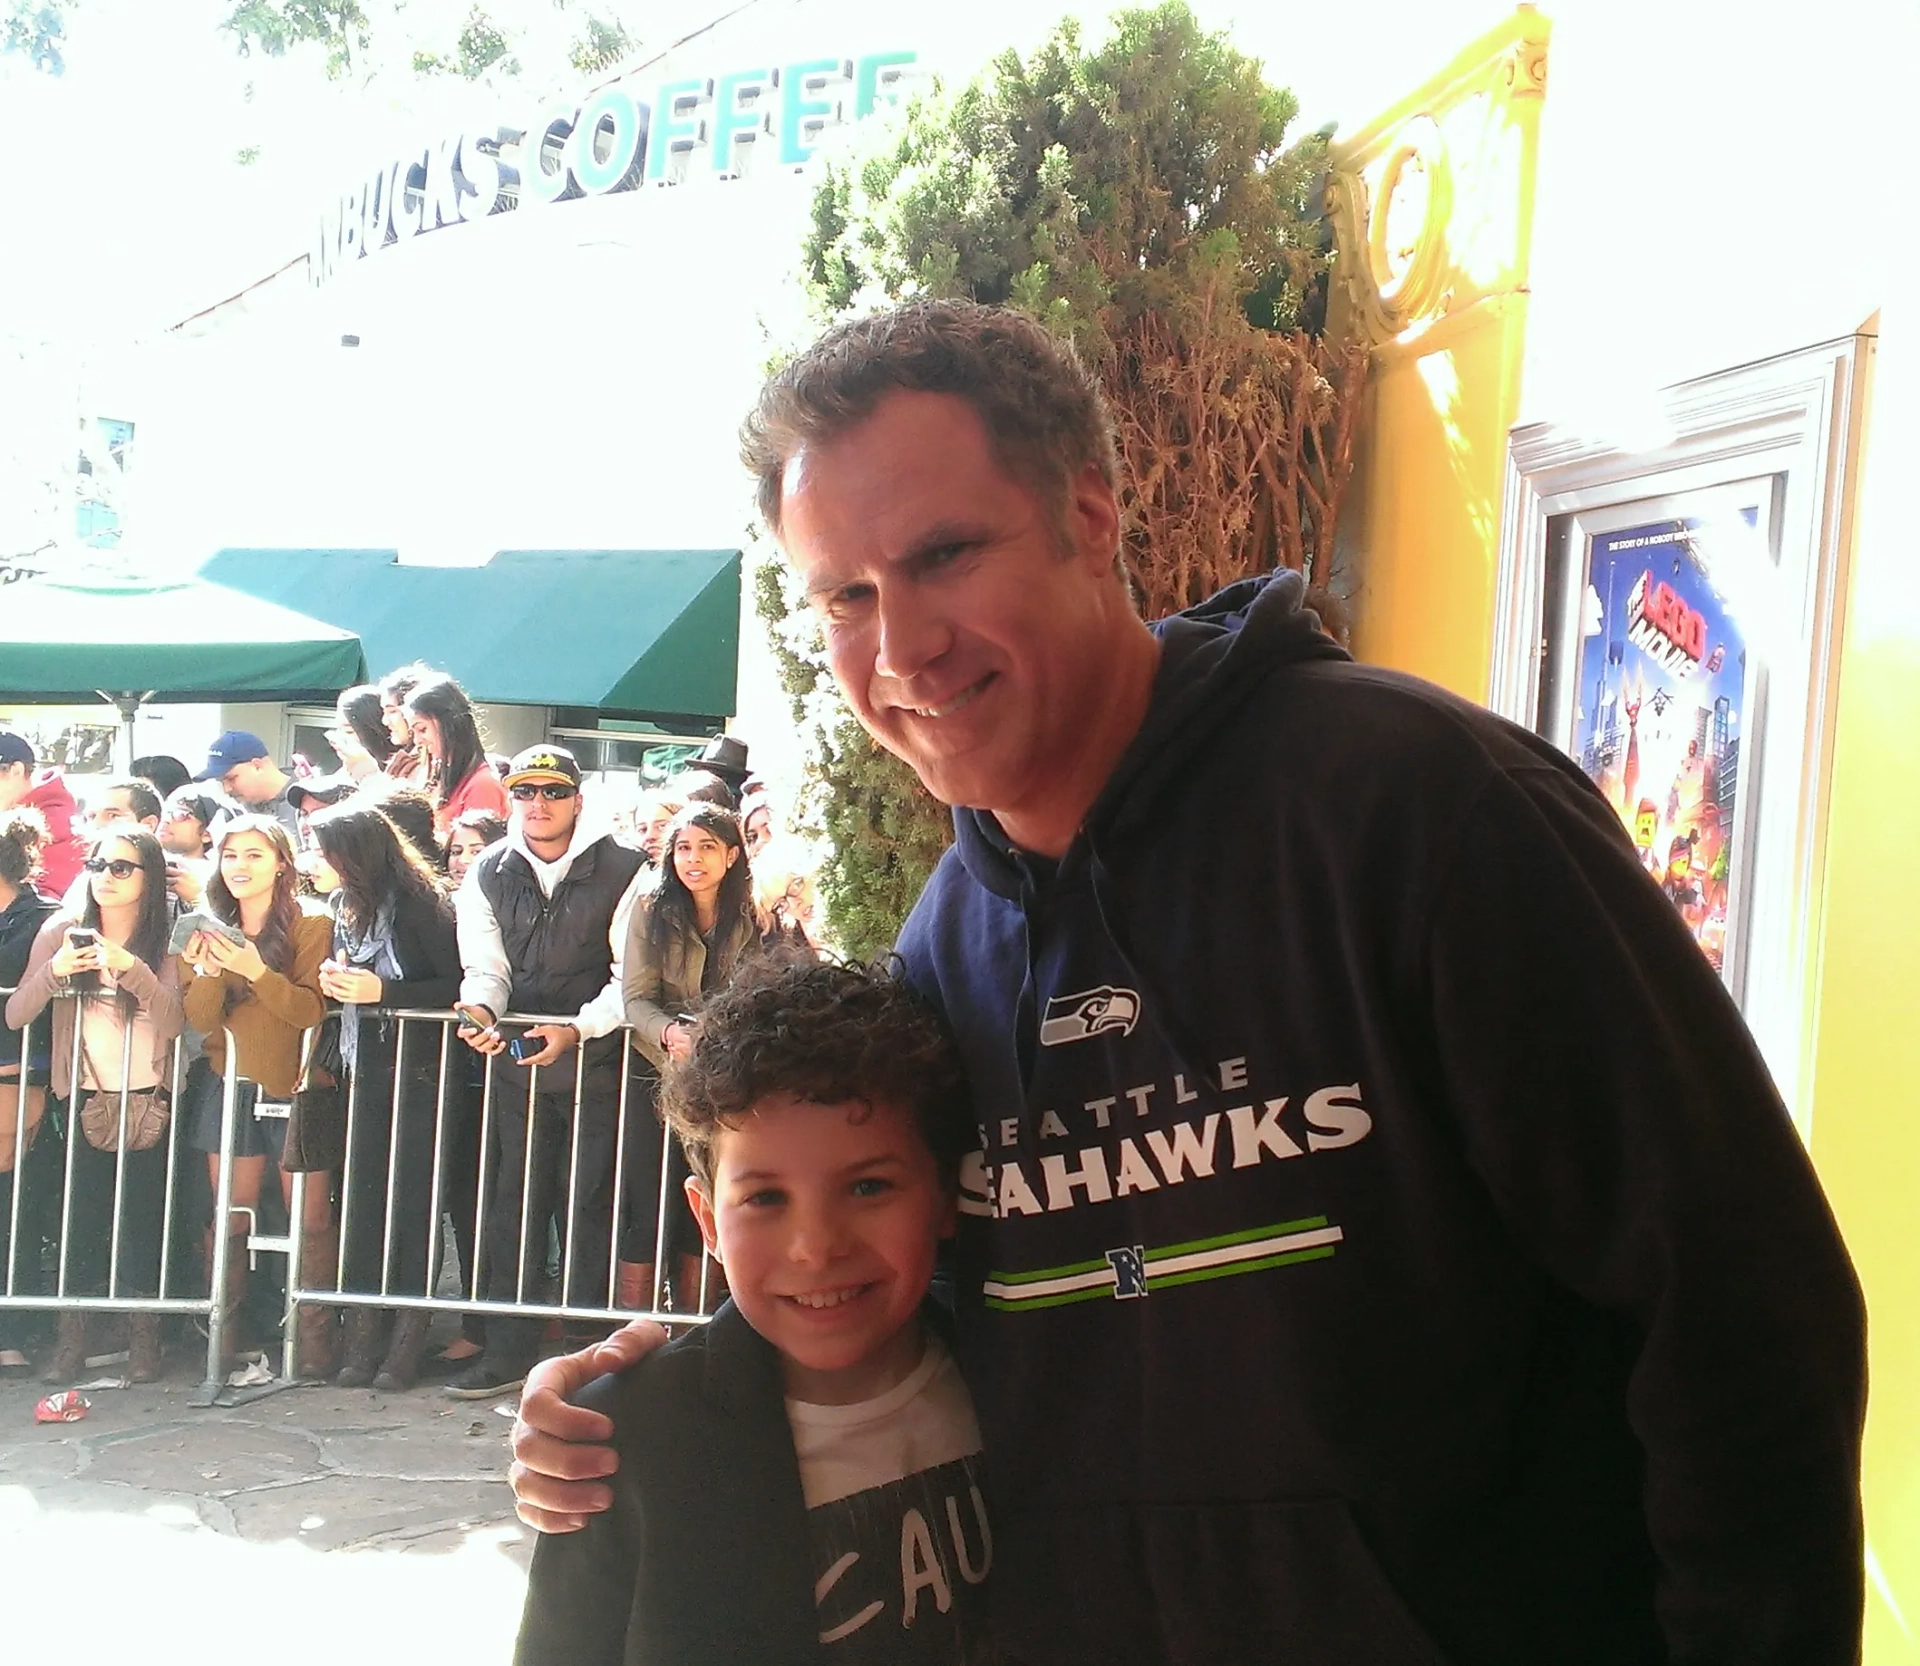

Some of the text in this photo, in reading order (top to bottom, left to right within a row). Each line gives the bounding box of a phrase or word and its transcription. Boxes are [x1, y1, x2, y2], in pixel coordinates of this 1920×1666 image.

[305, 128, 524, 284] BUCKS
[1619, 539, 1636, 550] STORY
[1636, 537, 1644, 548] OF
[1628, 617, 1699, 683] MOVIE
[1643, 570, 1706, 660] LEGO
[978, 1056, 1249, 1150] SEATTLE
